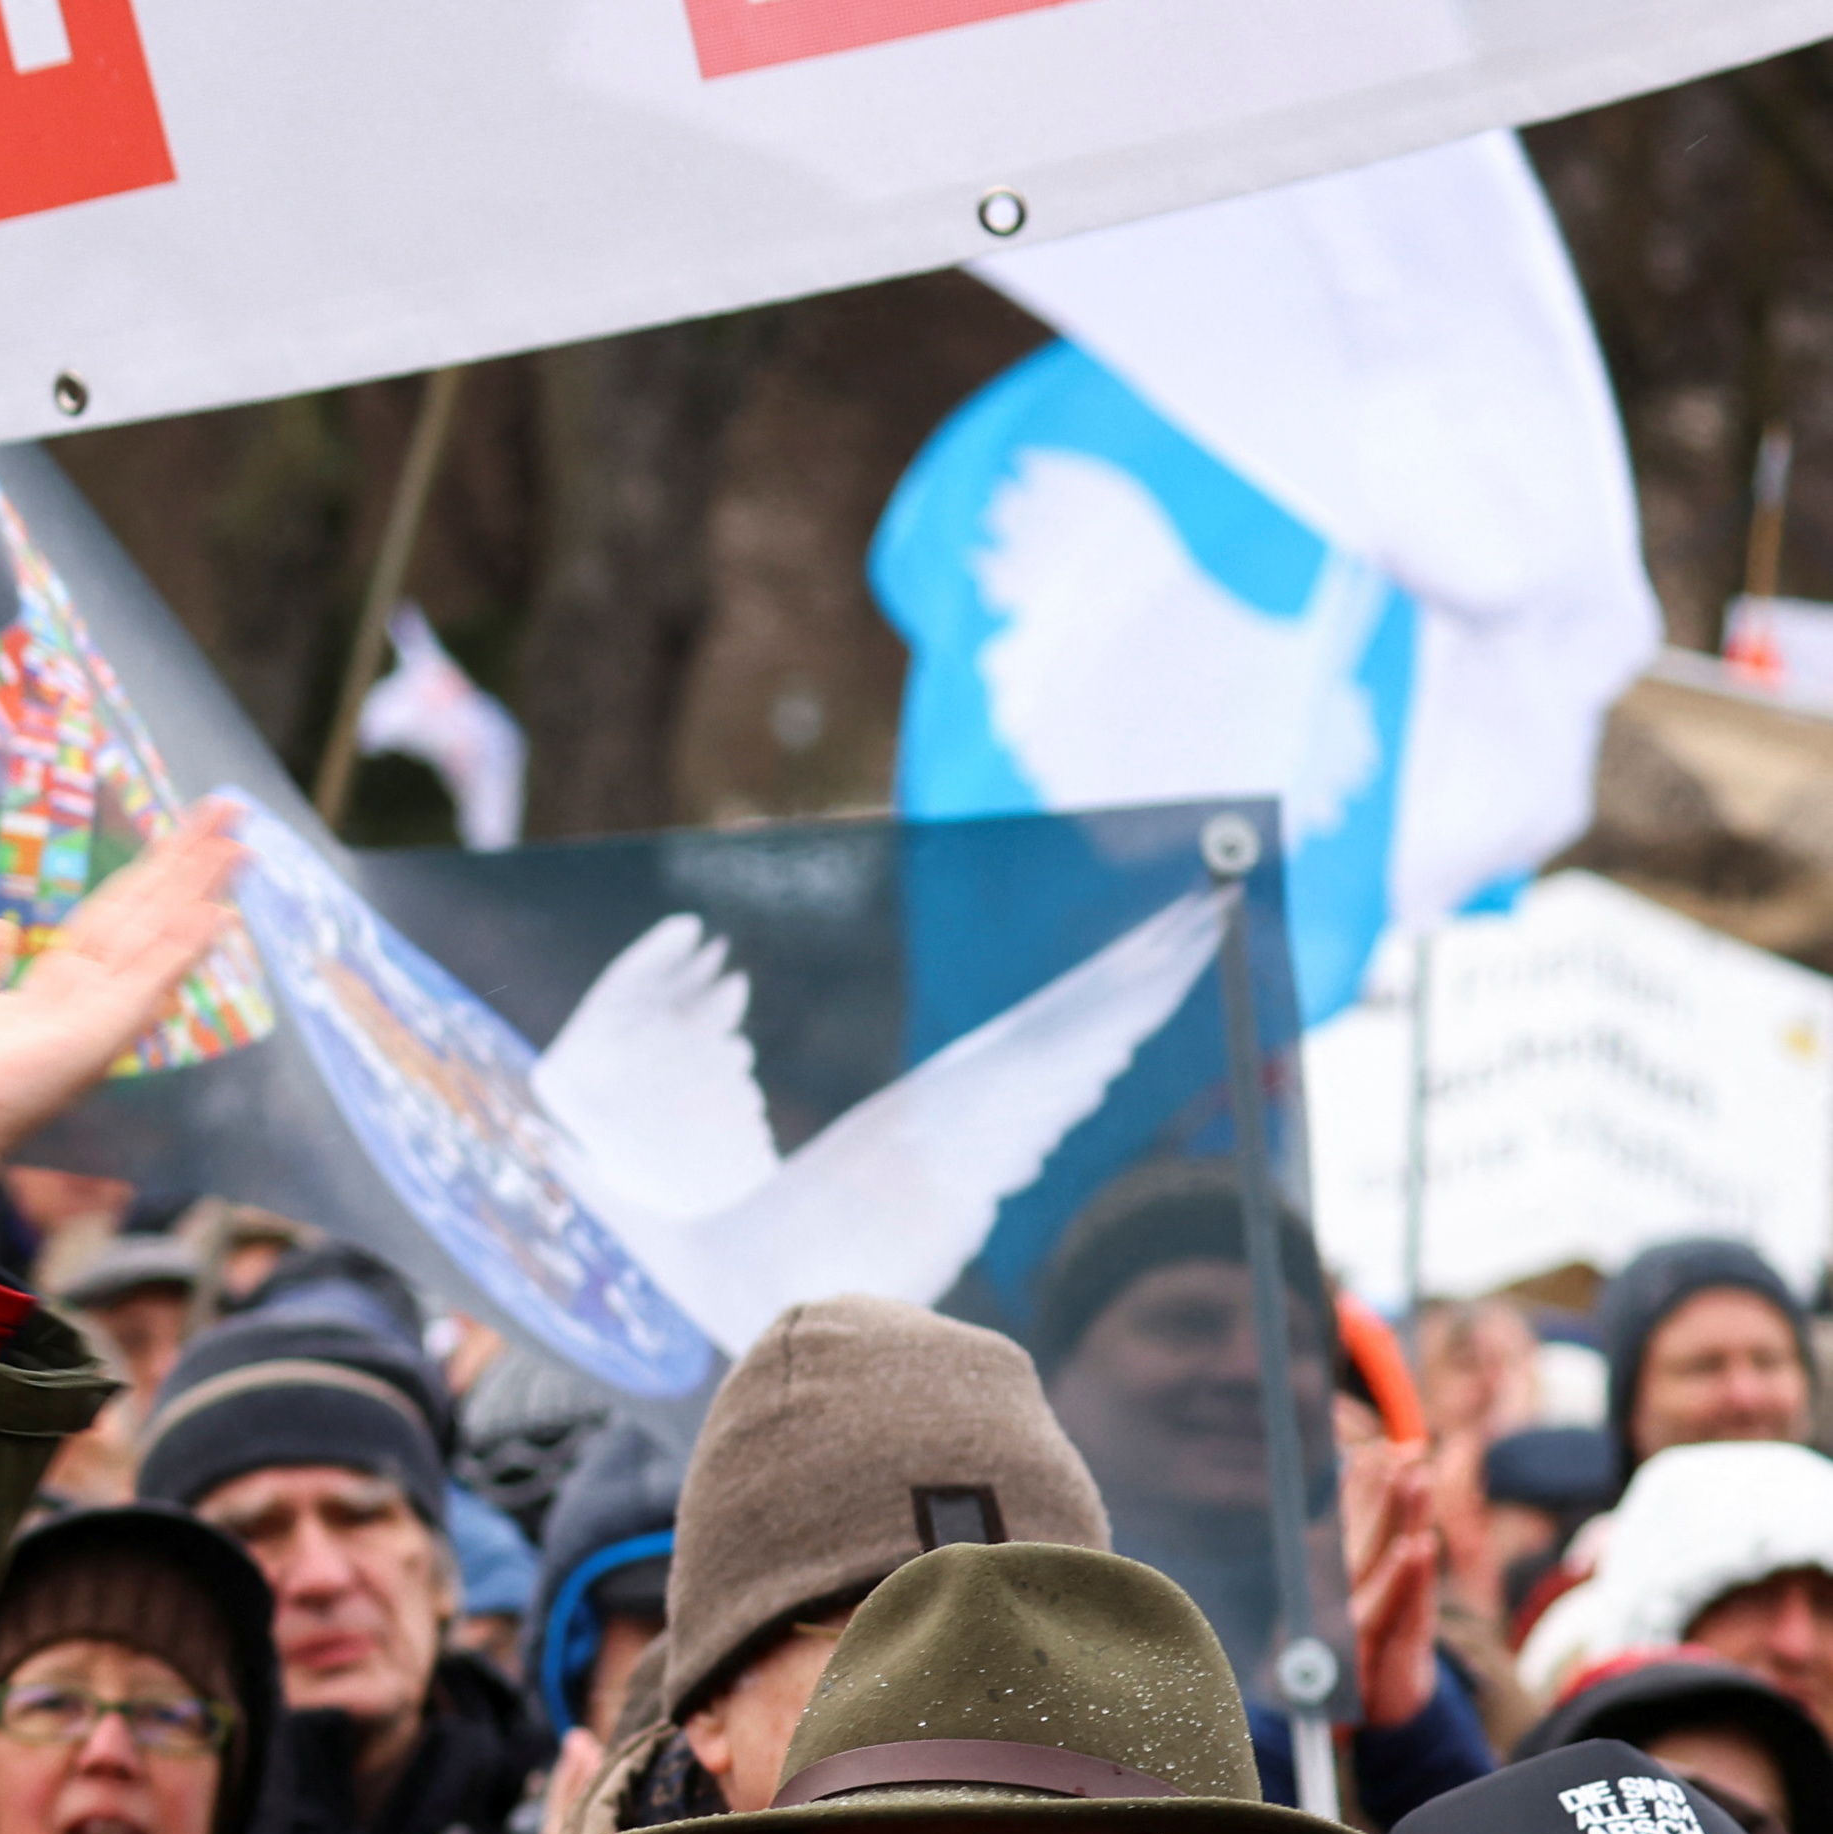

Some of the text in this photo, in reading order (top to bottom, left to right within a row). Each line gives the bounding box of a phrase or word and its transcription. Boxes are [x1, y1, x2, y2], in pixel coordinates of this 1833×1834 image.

[1558, 1776, 1687, 1814] DIE SIND
[1576, 1799, 1698, 1831] ALLE AM
